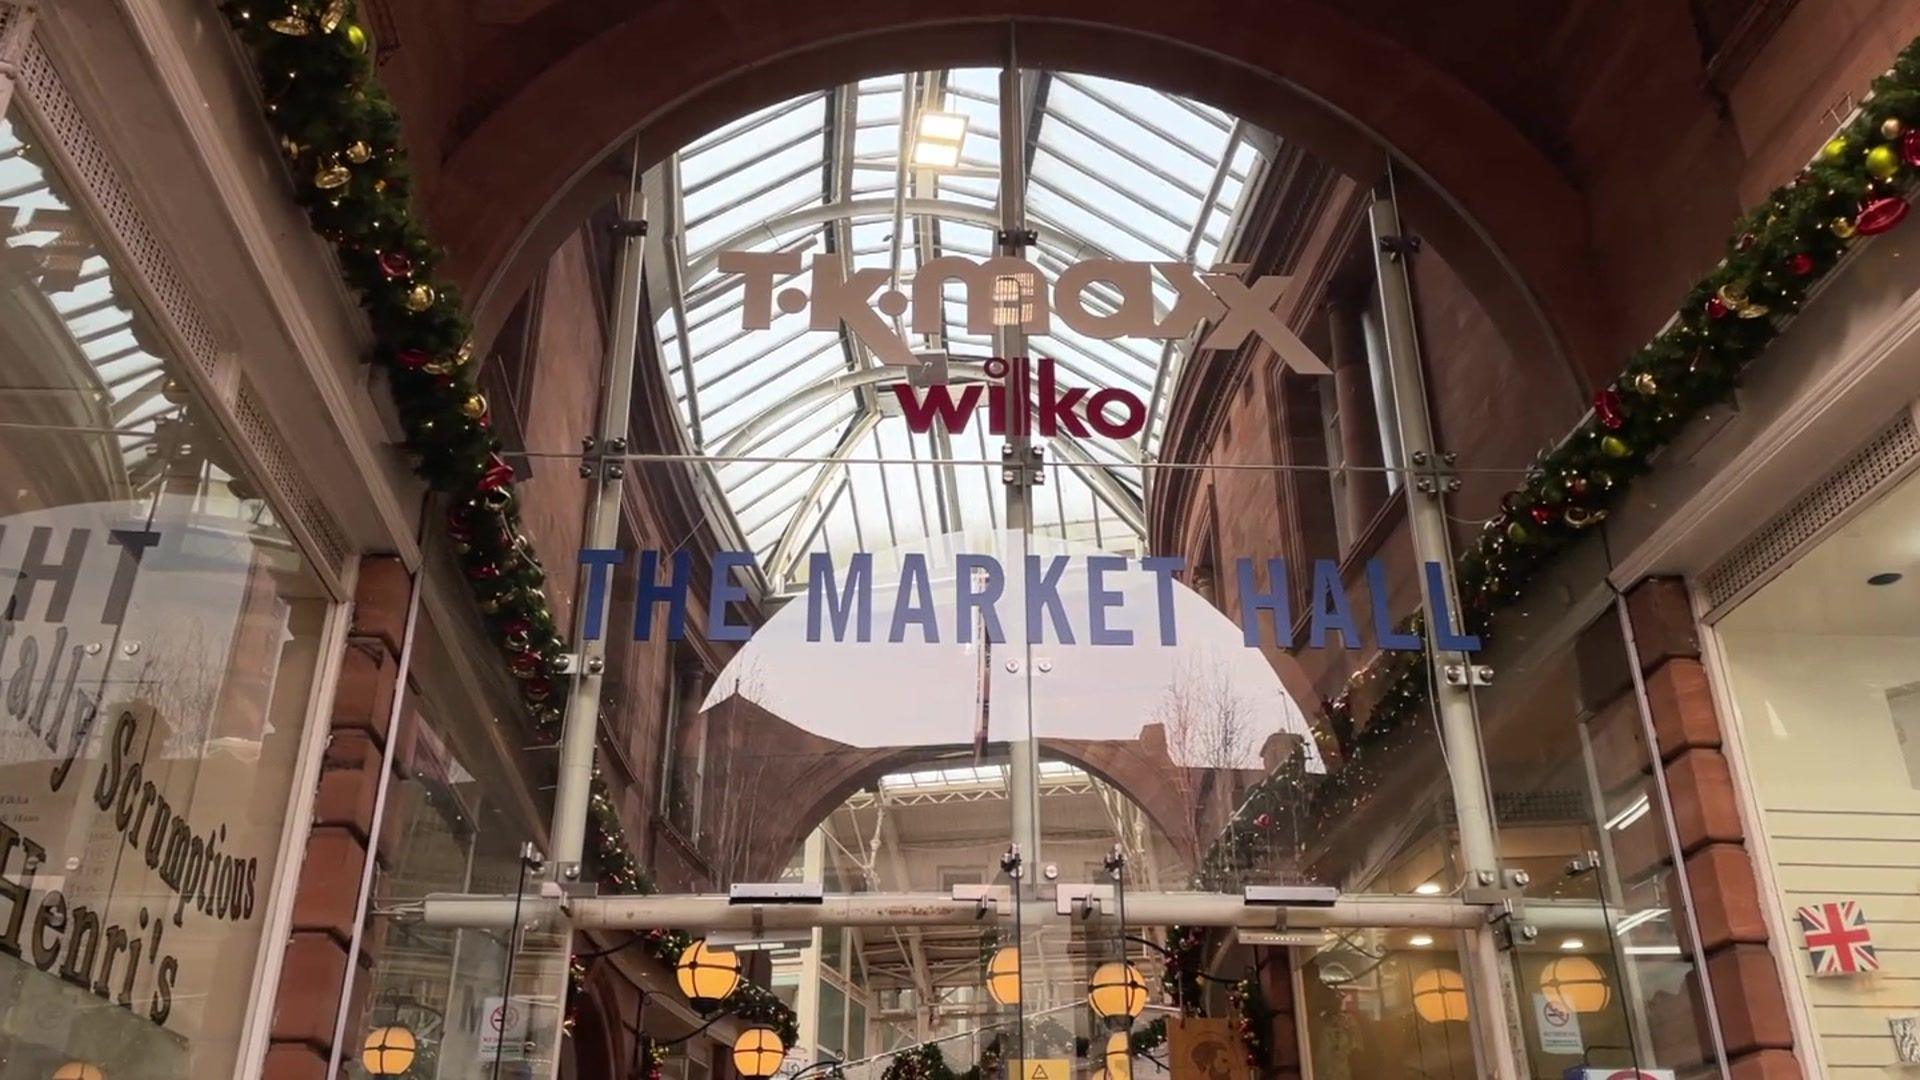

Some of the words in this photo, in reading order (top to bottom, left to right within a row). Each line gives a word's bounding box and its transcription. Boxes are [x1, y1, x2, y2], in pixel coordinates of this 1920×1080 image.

[892, 356, 1147, 440] wilko
[578, 549, 754, 642] THE
[806, 552, 1184, 646] MARKET
[1237, 558, 1481, 651] HALL
[94, 709, 258, 927] Scrumptious
[0, 820, 178, 1026] Henri's
